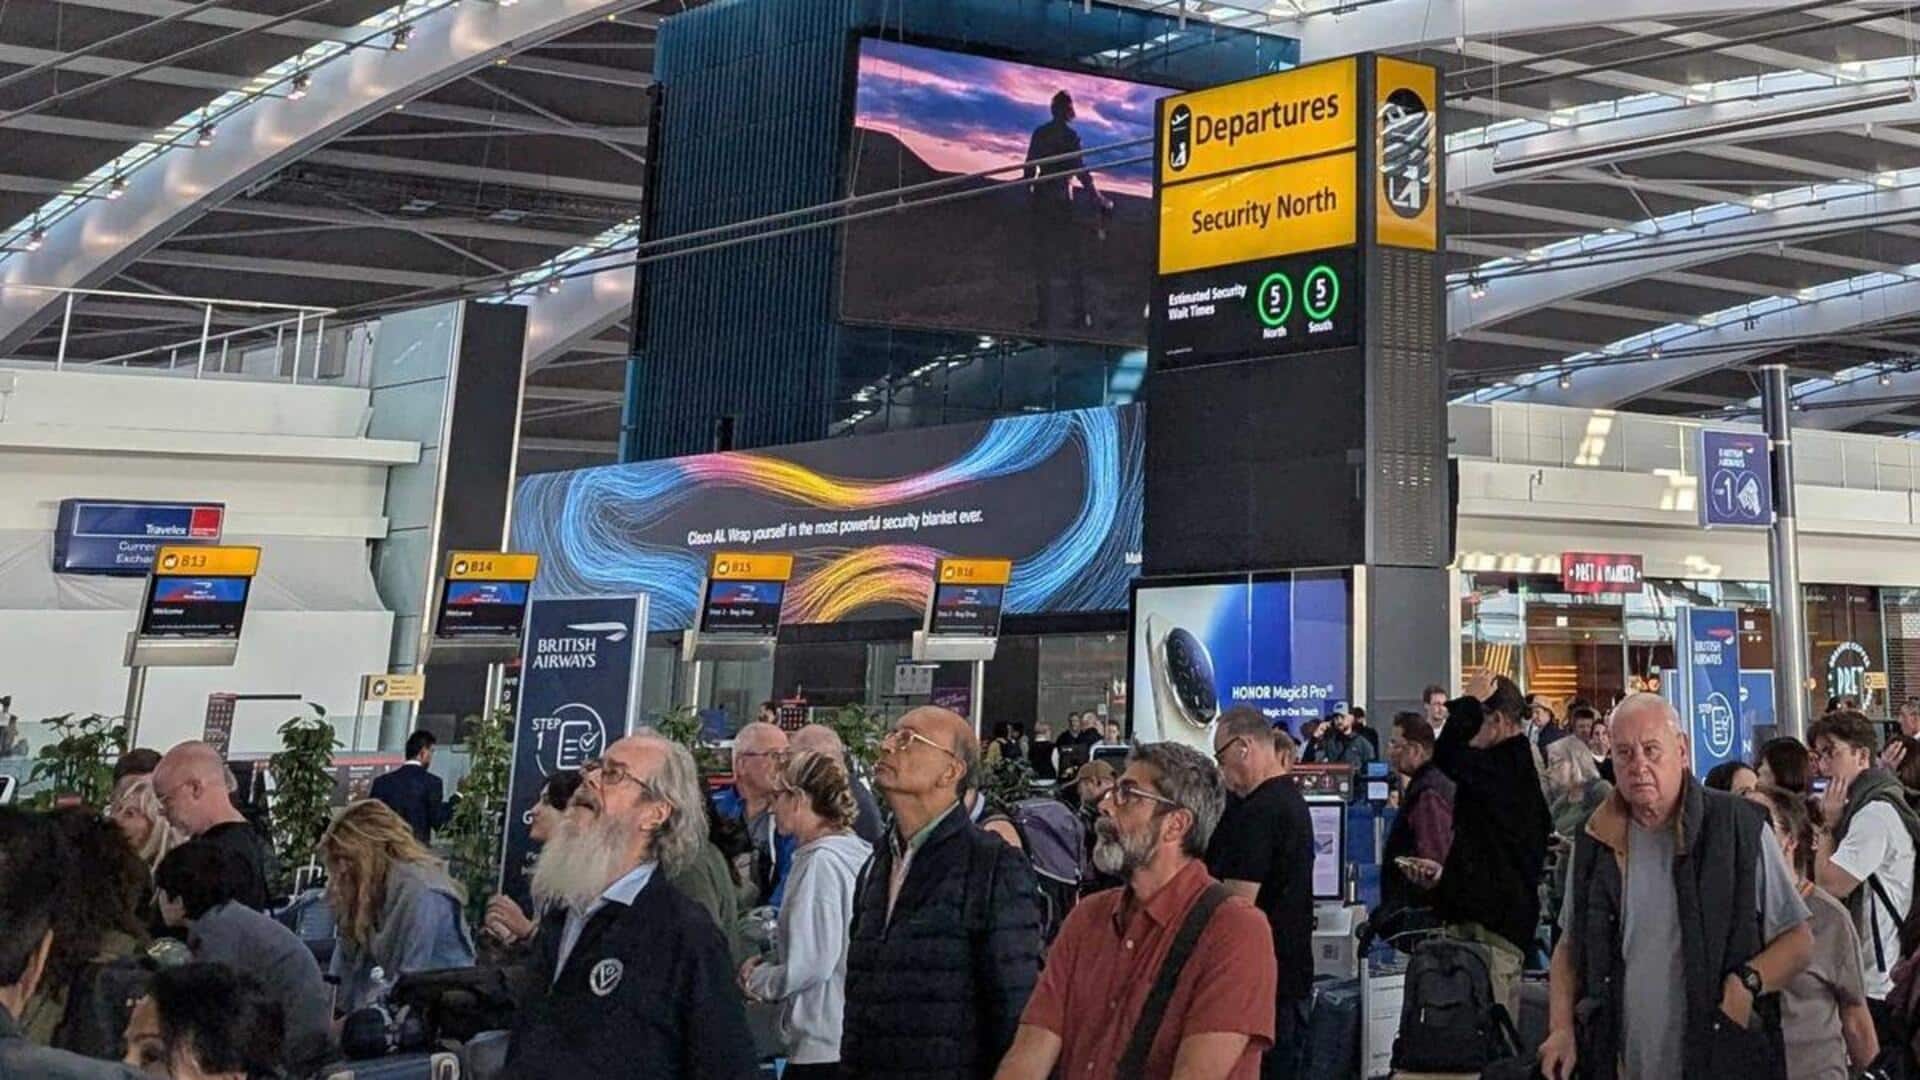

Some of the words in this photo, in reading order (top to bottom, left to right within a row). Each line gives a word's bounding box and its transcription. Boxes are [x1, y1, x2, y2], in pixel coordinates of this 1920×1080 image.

[1195, 93, 1339, 146] Departures
[1192, 200, 1271, 235] Security
[1277, 186, 1337, 220] North
[1168, 287, 1211, 307] Estimated
[1212, 283, 1248, 300] Security
[1270, 284, 1281, 306] 5
[1315, 277, 1326, 299] 5
[1168, 306, 1189, 321] Wait
[1190, 303, 1216, 319] Times
[1263, 326, 1288, 339] North
[1308, 319, 1333, 333] South
[145, 523, 187, 536] Travelex
[687, 529, 713, 546] Cisco
[728, 527, 751, 545] Wrap
[752, 522, 787, 544] yourself
[788, 523, 797, 537] in
[799, 522, 813, 536] the
[815, 520, 838, 535] most
[839, 514, 881, 535] powerful
[882, 513, 920, 533] security
[921, 509, 957, 527] blanket
[959, 510, 983, 524] ever.
[180, 555, 207, 568] B13
[470, 562, 493, 573] B14
[731, 561, 751, 573] B15
[537, 637, 597, 653] BRITISH
[531, 653, 597, 669] AIRWAYS
[1232, 685, 1271, 699] HONOR
[1273, 684, 1308, 702] Magic8
[531, 717, 561, 731] STEP
[537, 731, 544, 751] 1
